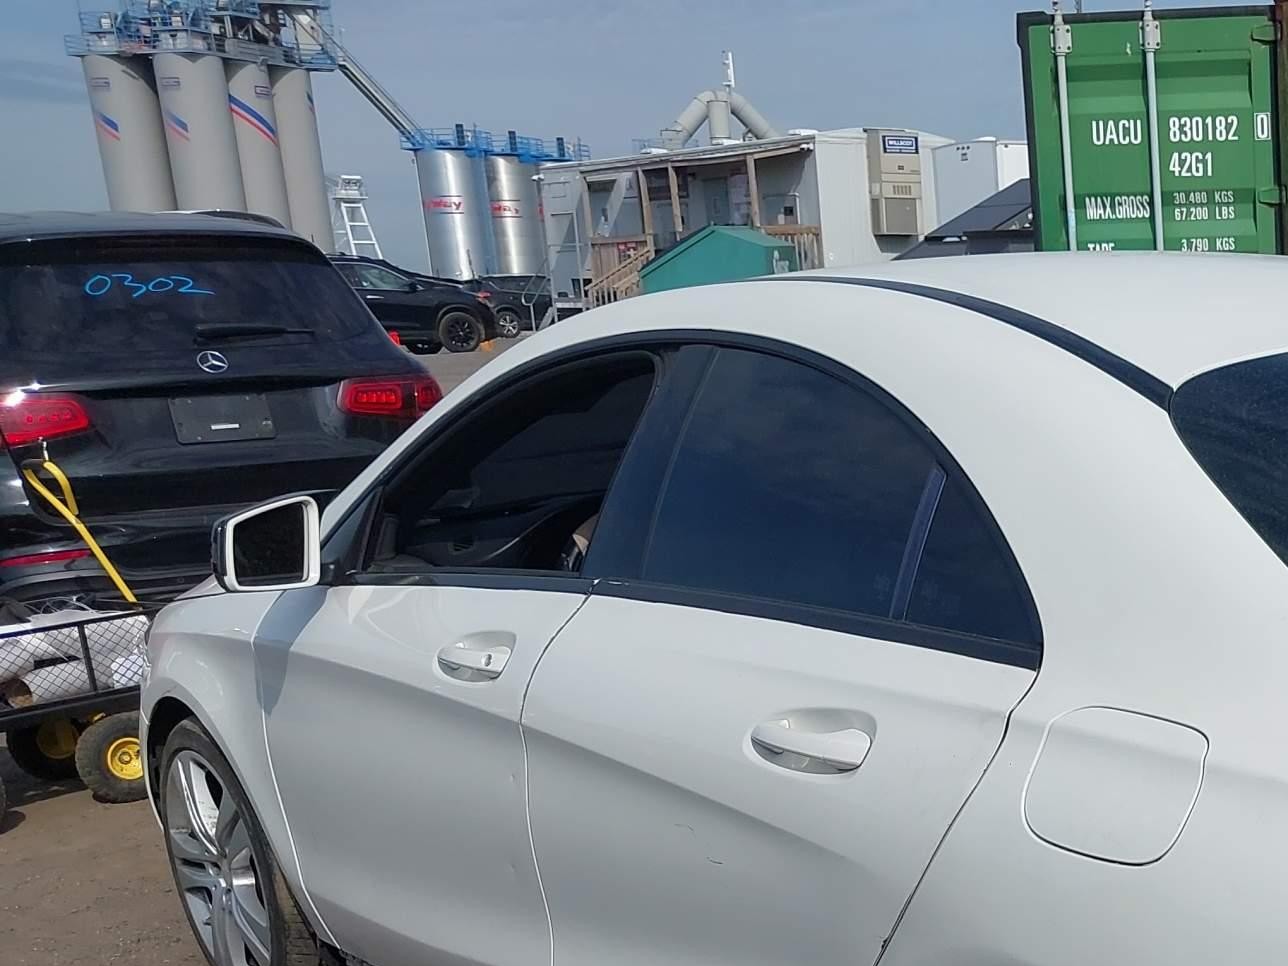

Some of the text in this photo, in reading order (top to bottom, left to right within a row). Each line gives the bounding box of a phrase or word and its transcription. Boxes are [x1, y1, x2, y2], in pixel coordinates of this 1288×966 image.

[1091, 114, 1268, 145] UACU 830182 0
[1168, 152, 1213, 177] 42G1
[1085, 190, 1234, 220] MAX.GROSS 30.480 KGS
[1174, 206, 1235, 221] 67.200 LBS
[1181, 238, 1236, 252] 3.790 KGS
[85, 274, 217, 298] 0302
